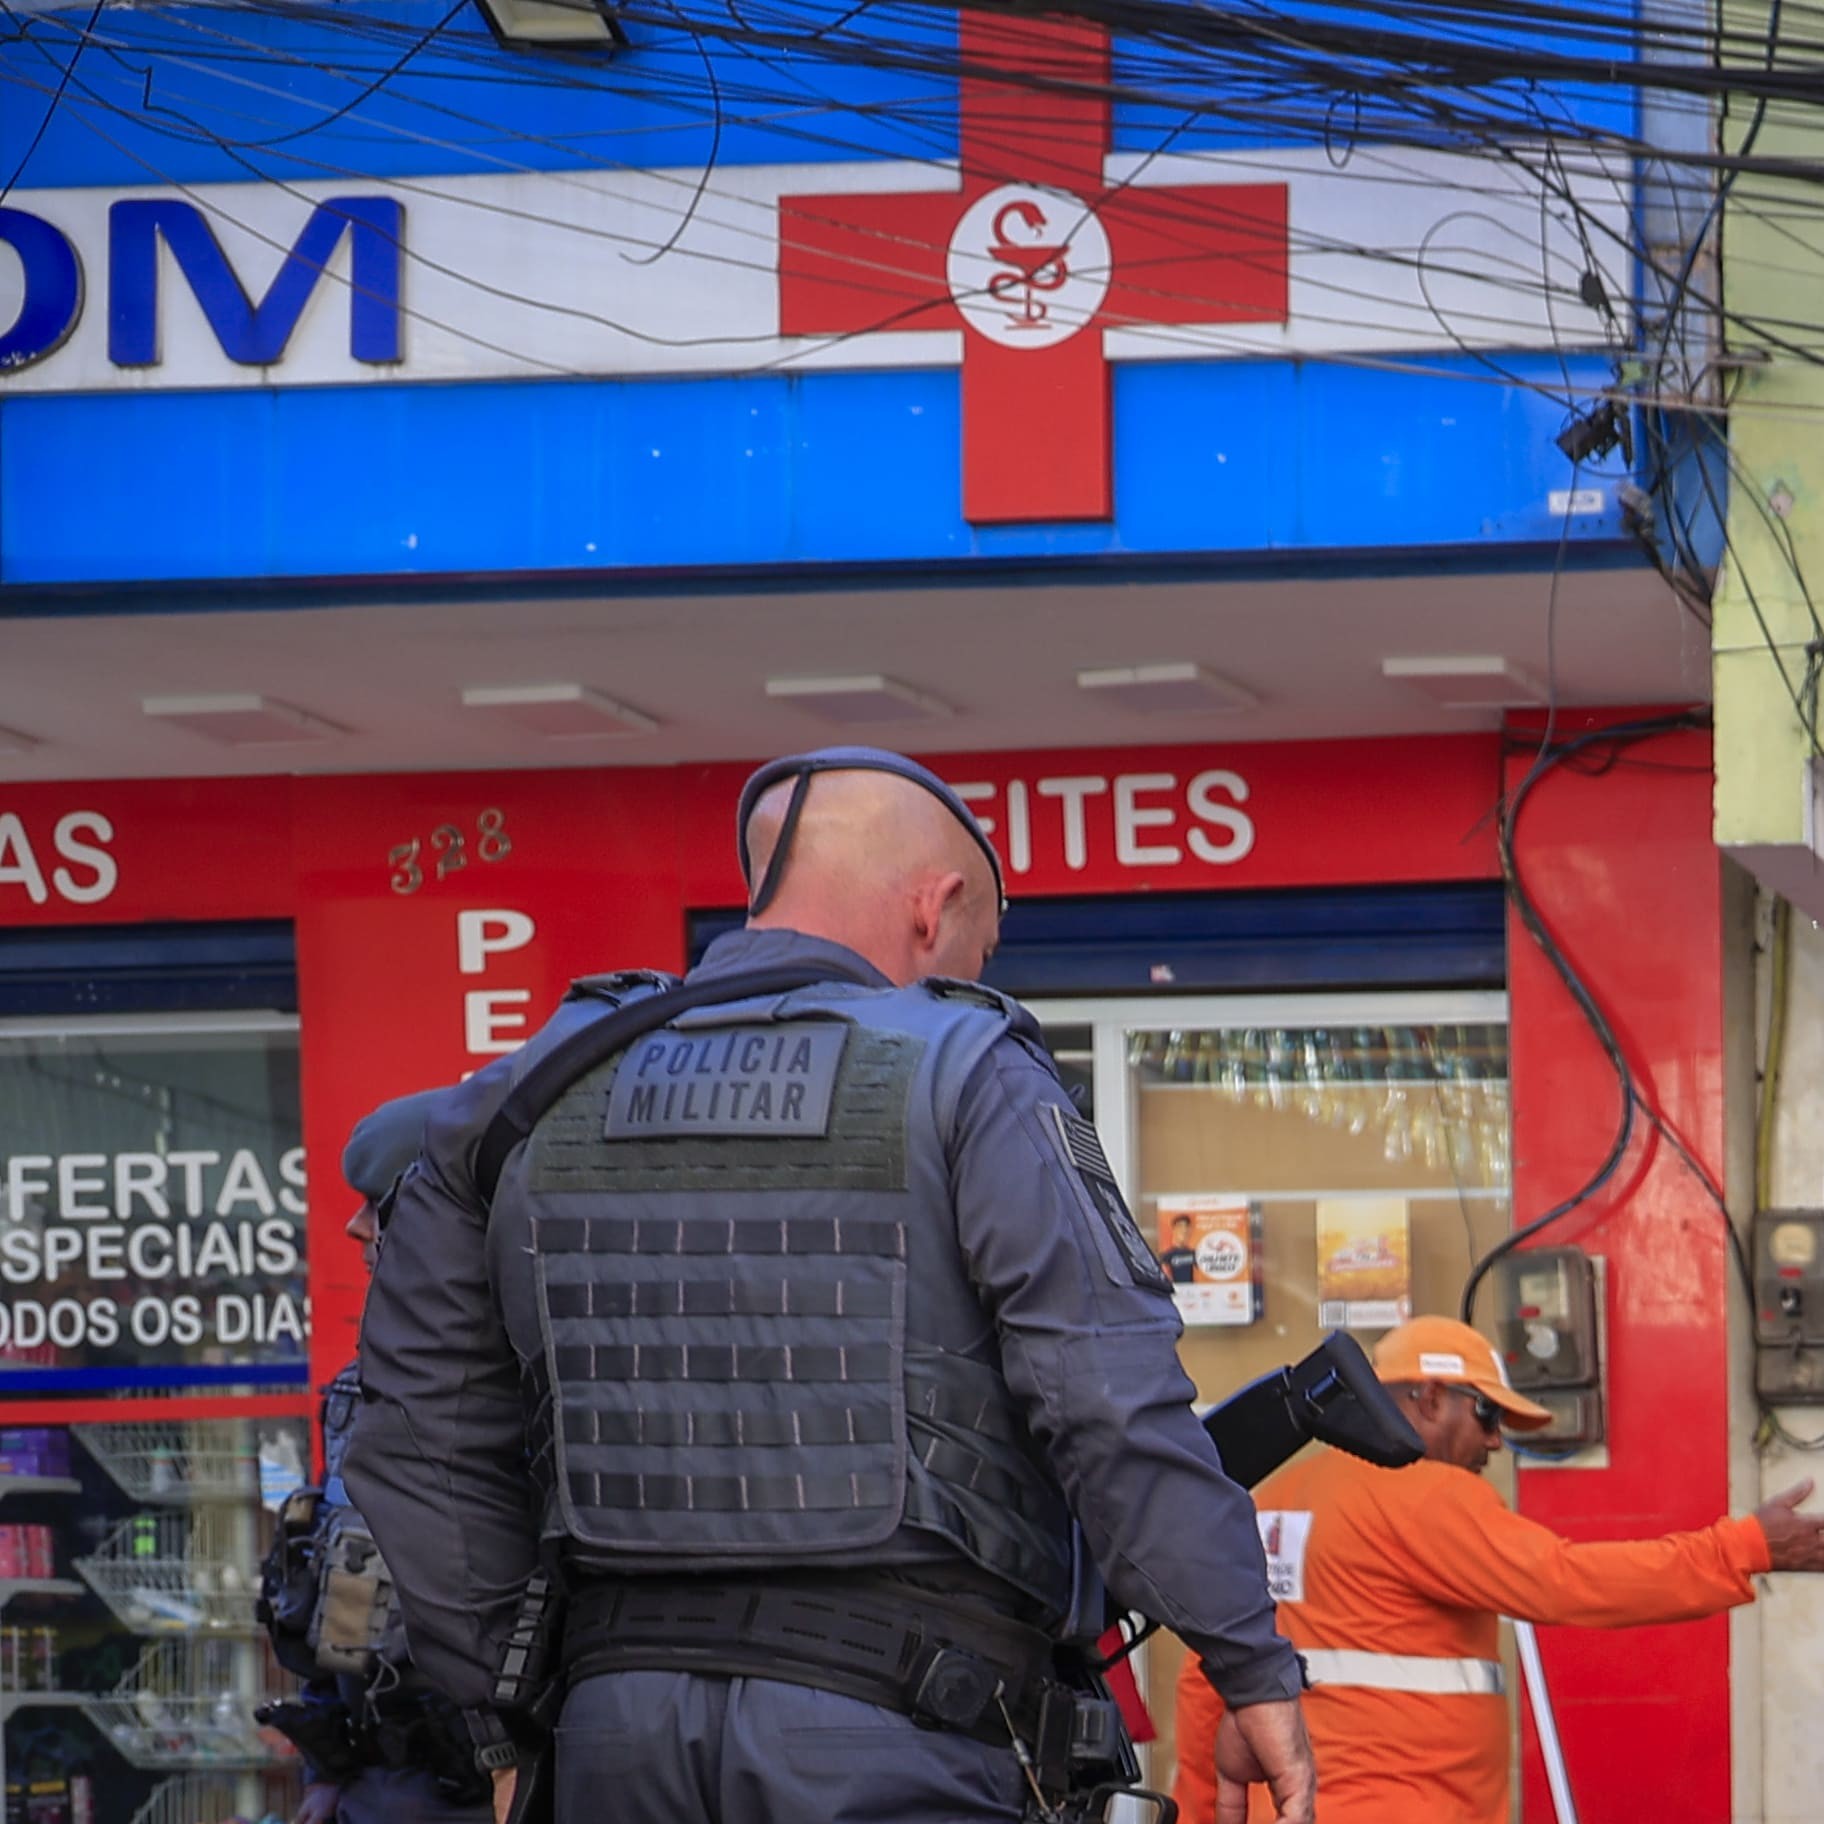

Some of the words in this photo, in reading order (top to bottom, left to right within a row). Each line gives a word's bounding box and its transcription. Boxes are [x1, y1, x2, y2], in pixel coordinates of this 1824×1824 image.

[389, 808, 511, 894] 328
[457, 909, 536, 1083] PE
[637, 1031, 812, 1078] POLÍCIA
[626, 1081, 806, 1124] MILITAR
[0, 1148, 308, 1221] FERTAS
[1, 1219, 299, 1282] SPECIAIS
[0, 1298, 120, 1348] DOS
[131, 1297, 203, 1346] OS
[216, 1293, 312, 1343] DIA
